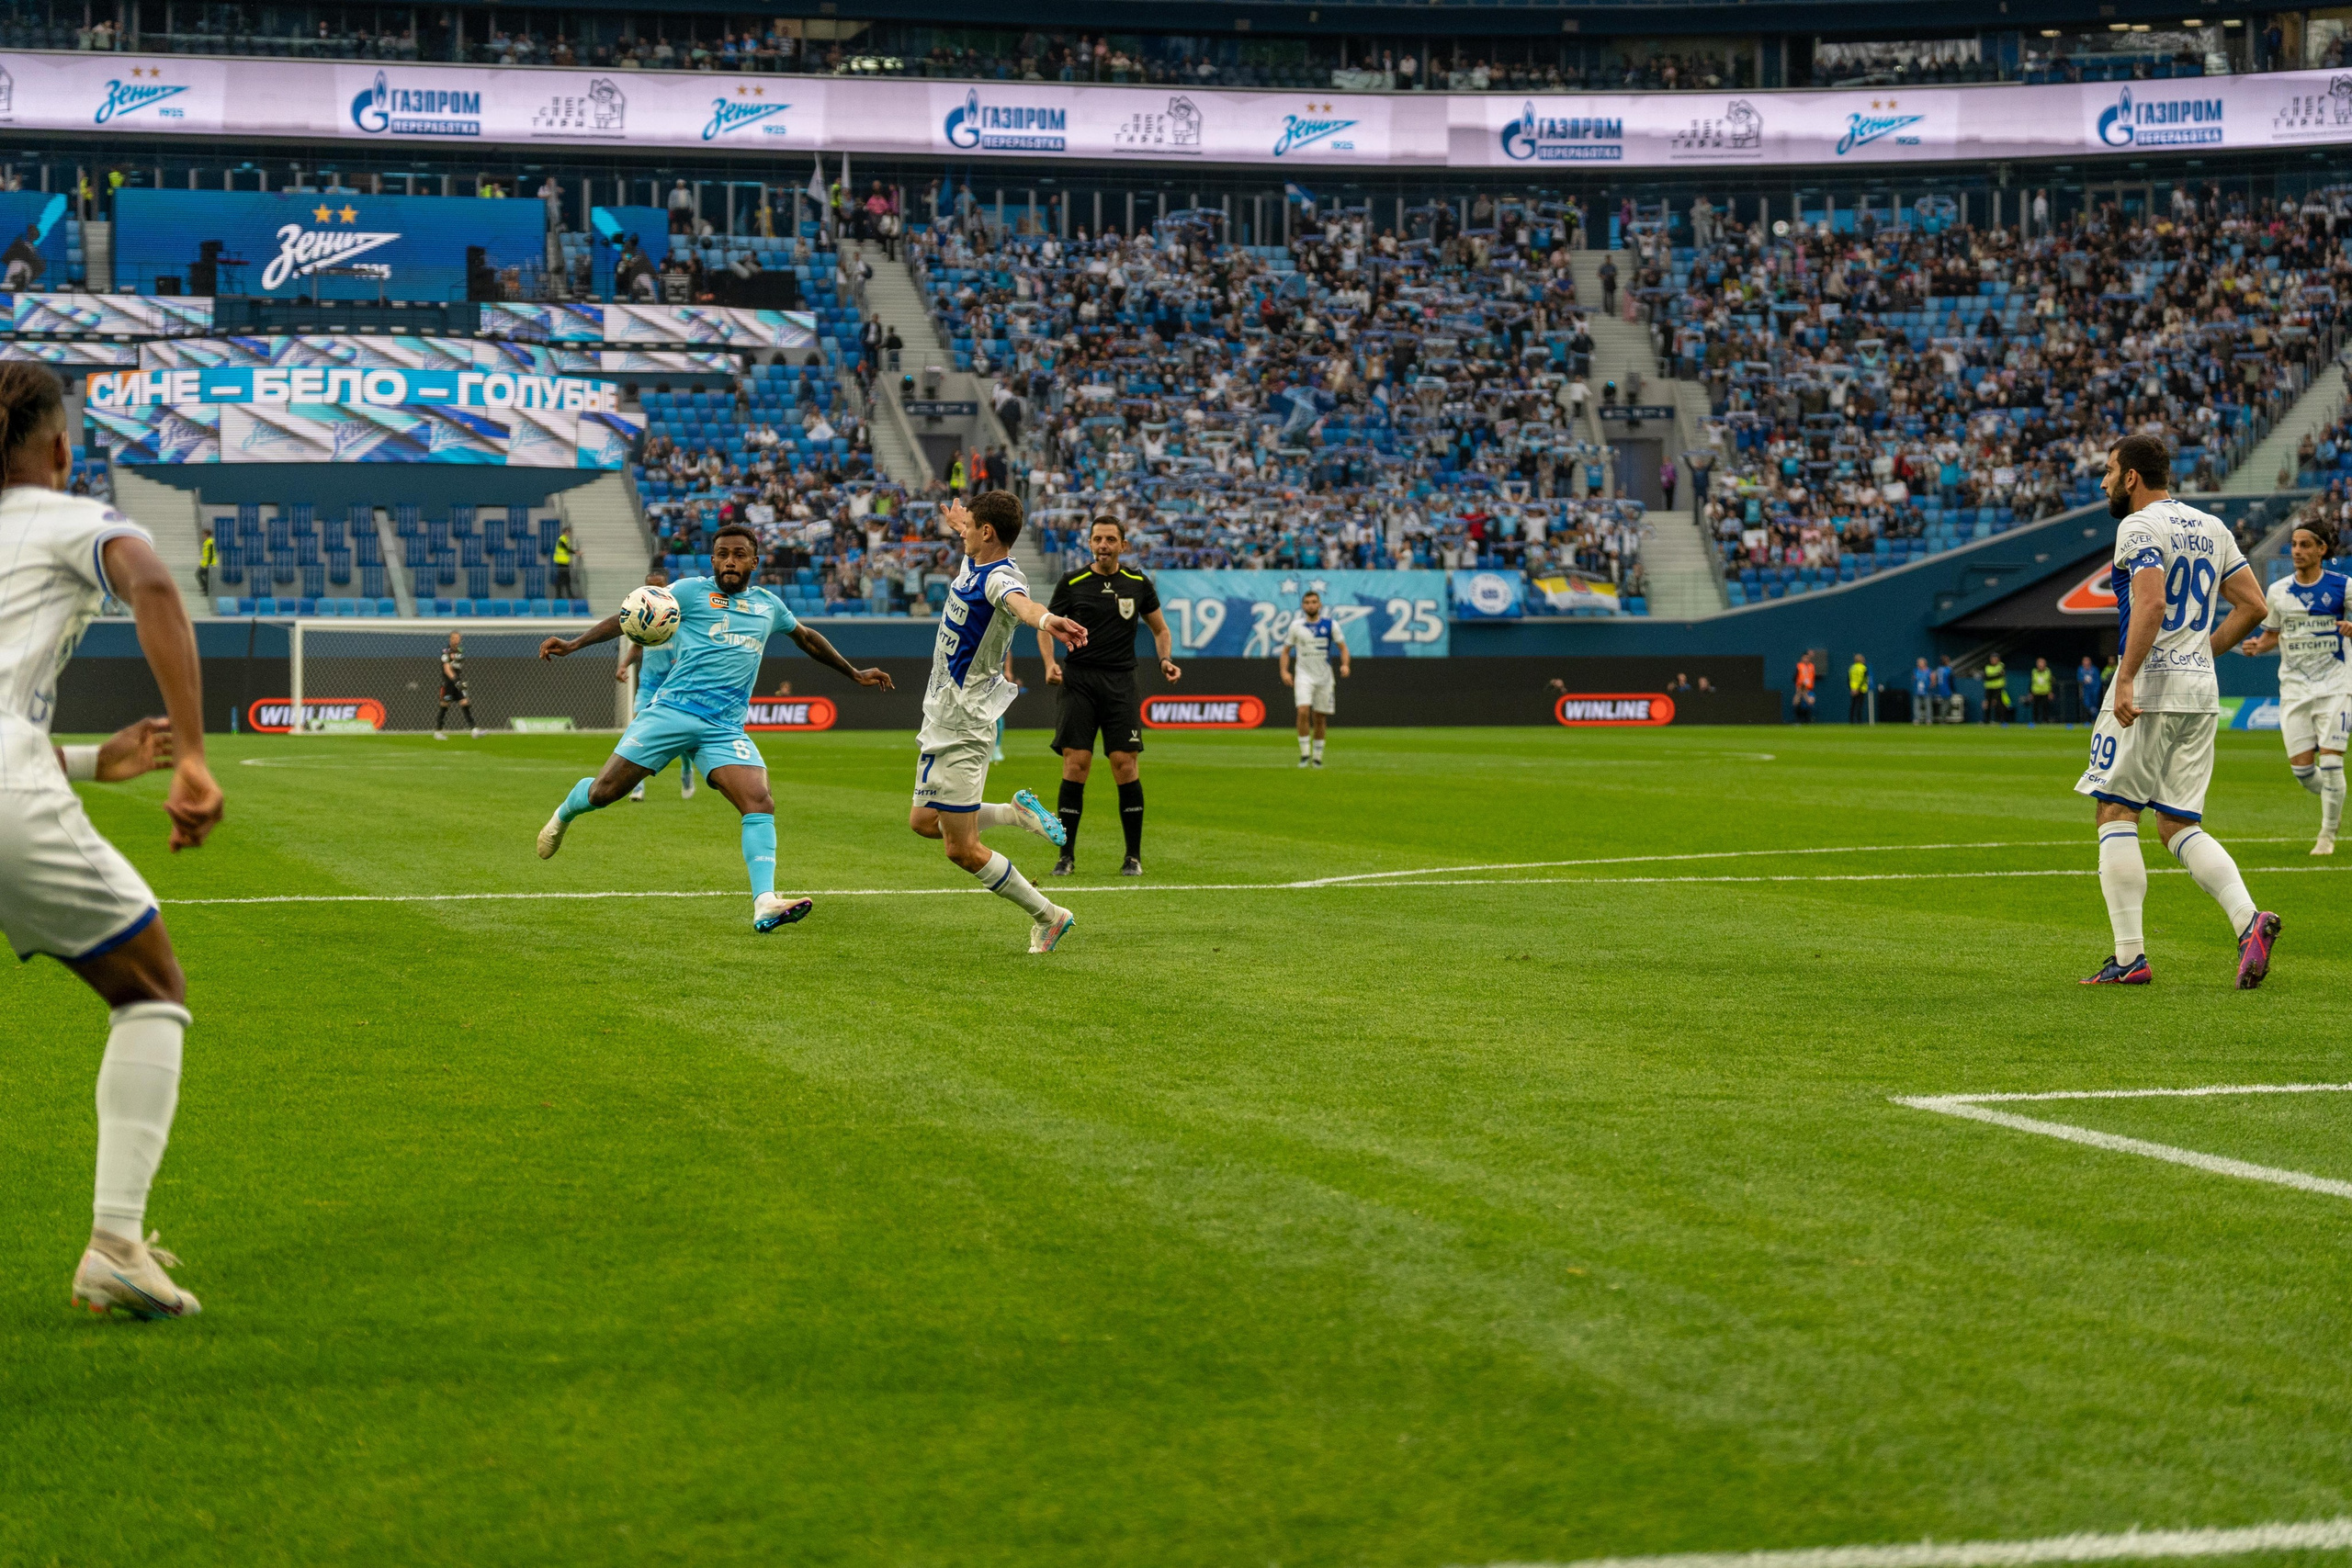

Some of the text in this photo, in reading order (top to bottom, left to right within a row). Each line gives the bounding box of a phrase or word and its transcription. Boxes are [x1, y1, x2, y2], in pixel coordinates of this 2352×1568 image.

[391, 89, 480, 114] ГАЗПРОМ
[2136, 98, 2222, 124] ГАЗПРОМ
[982, 106, 1065, 130] ГАЗПРОМ
[1539, 118, 1622, 139] ГАЗПРОМ
[91, 369, 201, 407] СИНЕ
[253, 368, 408, 405] БЕЛО
[458, 371, 616, 412] ГОЛУБЫЕ
[2161, 556, 2216, 632] 99
[1166, 598, 1227, 649] 19
[1381, 599, 1444, 642] 25
[2298, 618, 2335, 629] МАГНИТ
[2289, 639, 2337, 650] БЕТСИТИ
[1150, 703, 1238, 722] WINLINE
[1565, 700, 1649, 720] WINLINE
[732, 739, 752, 761] 8
[2089, 733, 2117, 770] 99
[922, 752, 935, 784] 7
